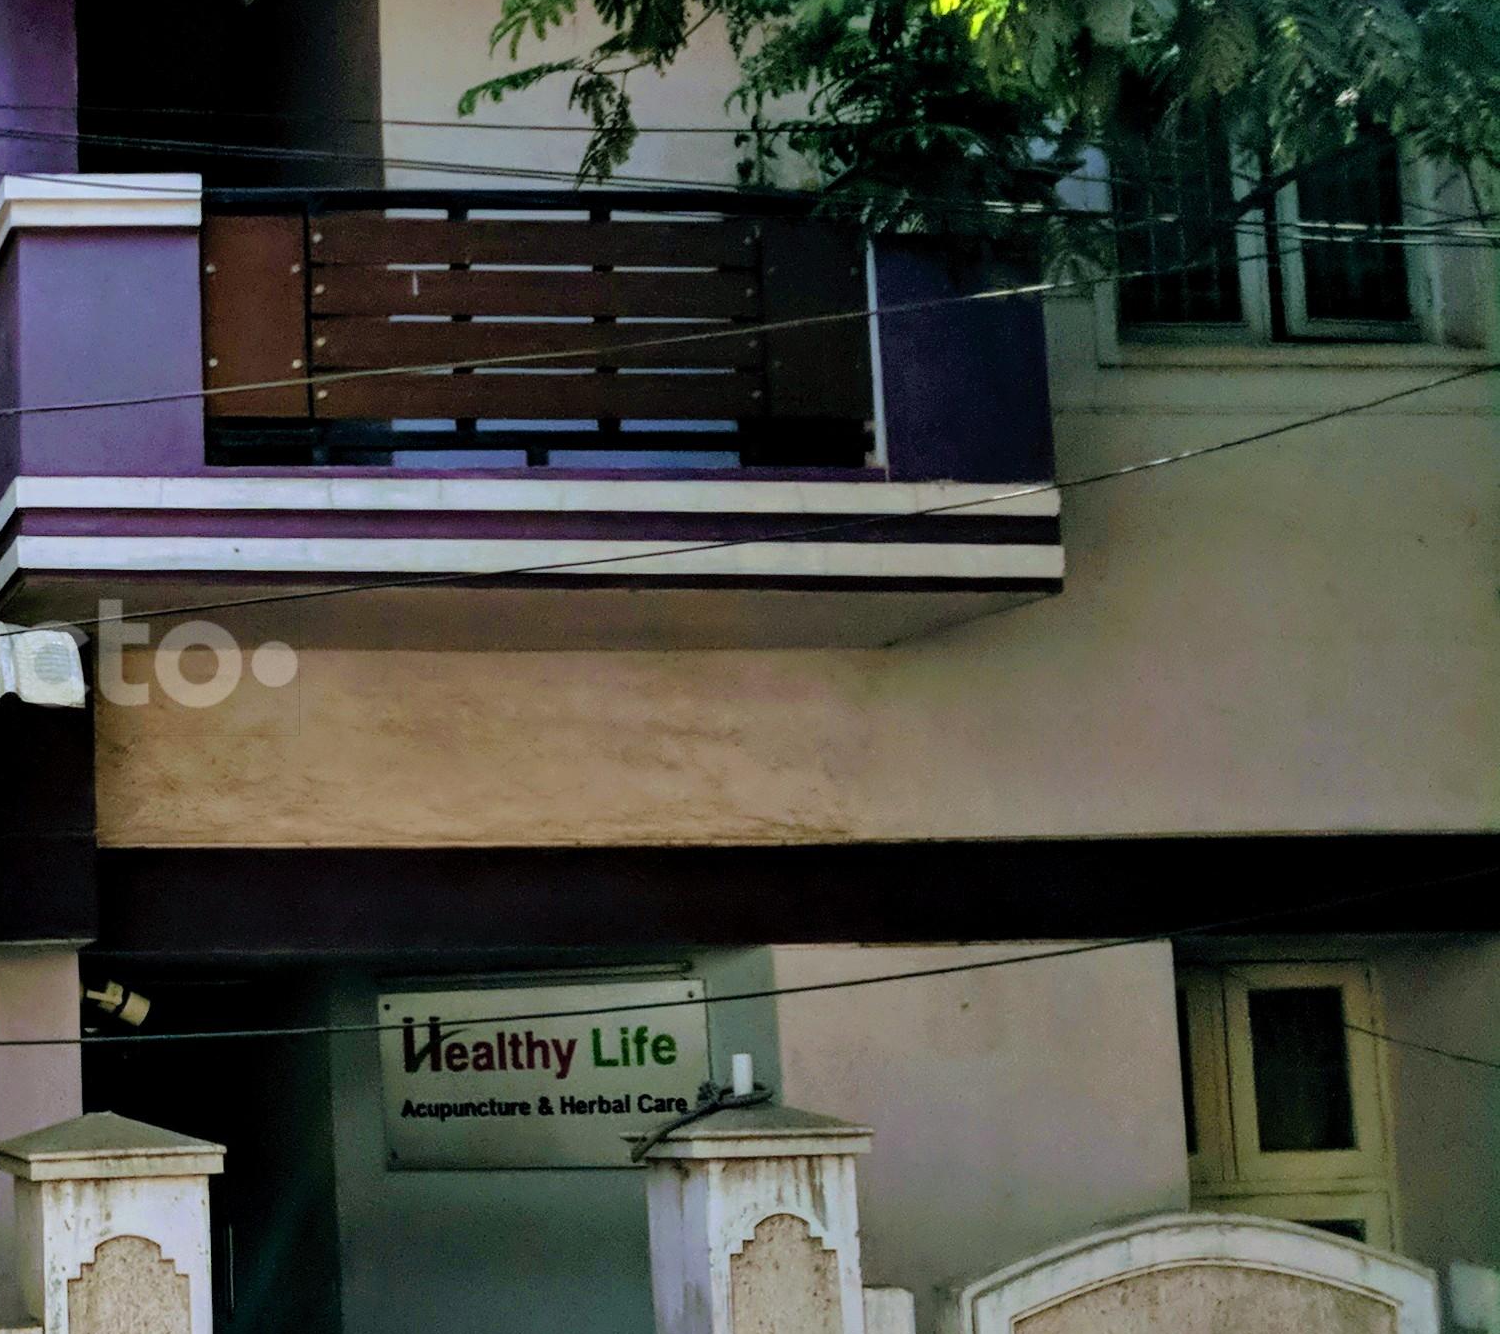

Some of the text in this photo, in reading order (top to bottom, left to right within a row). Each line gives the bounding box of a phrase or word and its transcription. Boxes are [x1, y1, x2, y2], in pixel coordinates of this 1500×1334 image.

[403, 1017, 677, 1079] Healthy Life
[401, 1094, 688, 1121] Acupuncture & Herbal Care
